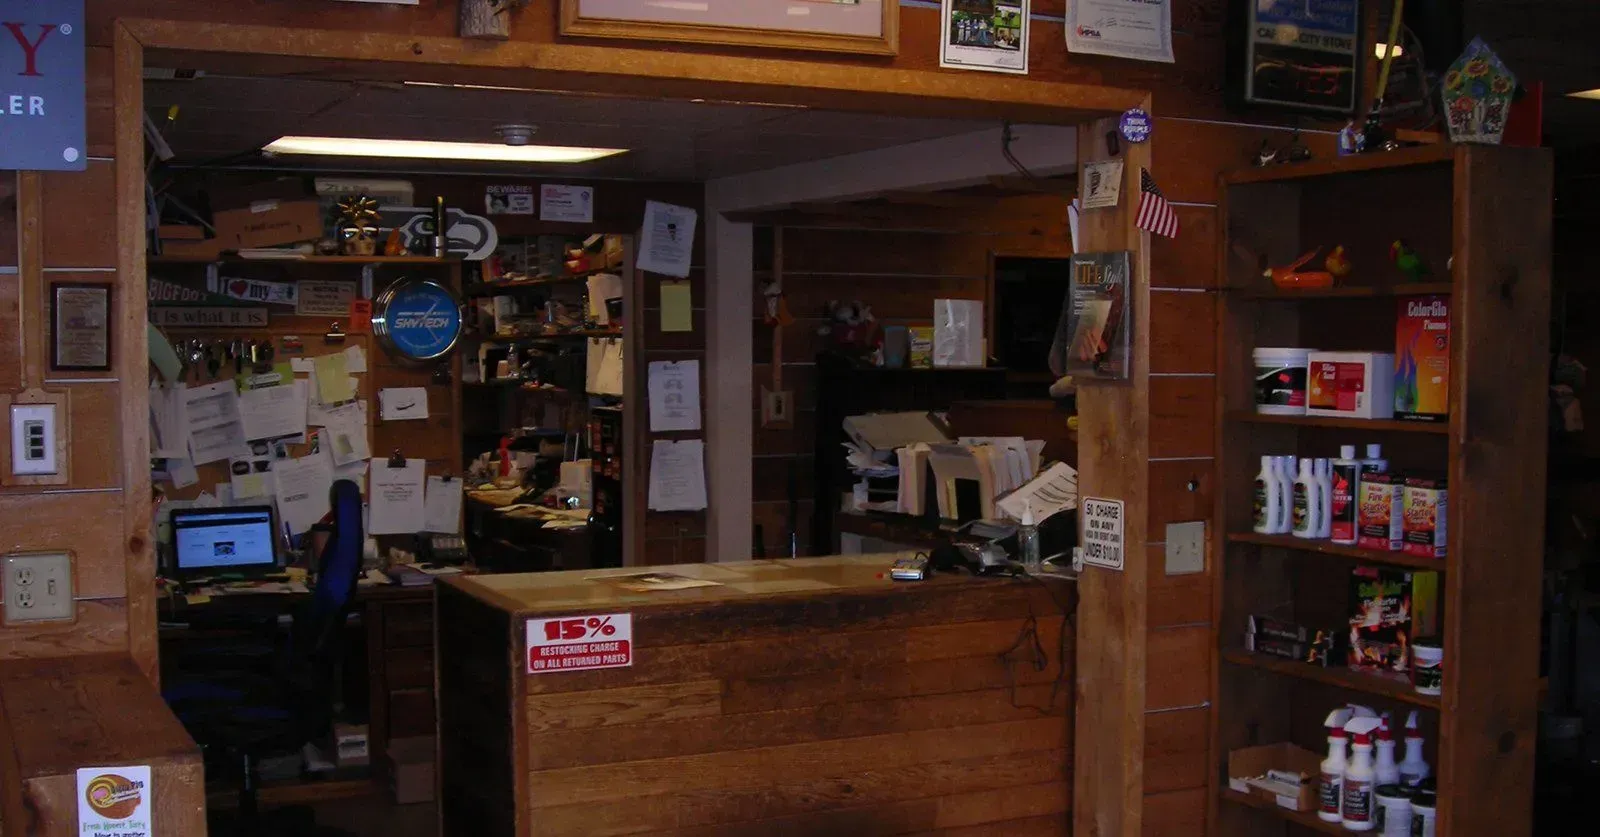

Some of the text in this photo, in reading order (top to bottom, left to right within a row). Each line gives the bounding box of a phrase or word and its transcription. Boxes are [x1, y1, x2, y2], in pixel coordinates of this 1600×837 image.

[0, 95, 45, 116] ER
[486, 184, 533, 194] BEWARE!
[250, 283, 270, 300] my
[183, 309, 224, 324] what
[230, 309, 241, 324] it
[1367, 492, 1383, 502] Fire
[1411, 498, 1427, 508] Fire
[1096, 504, 1119, 519] CHARGE
[1090, 520, 1114, 531] ON ANY
[544, 616, 616, 641] 15%
[540, 641, 620, 657] RESTOCKING CHARGE
[533, 653, 627, 669] ON ALL RETURNED PARTS
